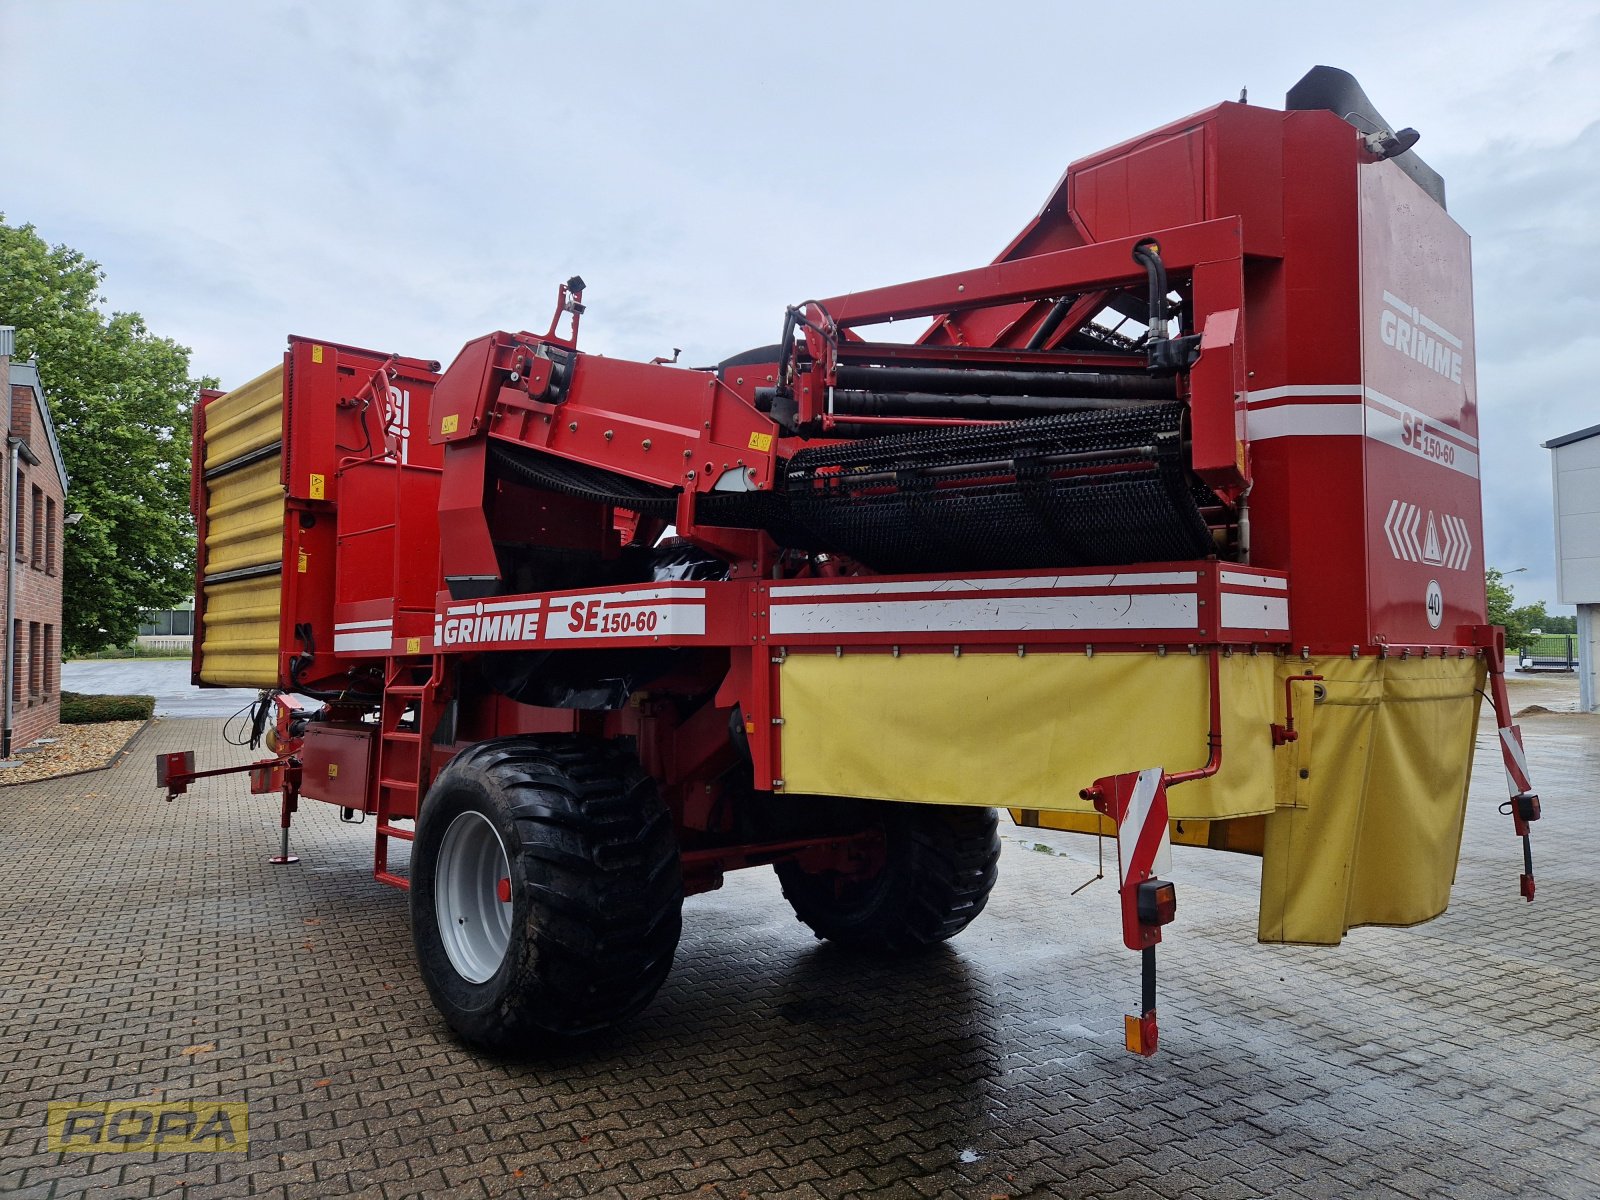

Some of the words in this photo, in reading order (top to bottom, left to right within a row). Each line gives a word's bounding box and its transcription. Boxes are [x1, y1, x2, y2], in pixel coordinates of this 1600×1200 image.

[1379, 307, 1463, 385] GRIMME
[1401, 411, 1424, 451] SE
[1423, 435, 1455, 466] 150-60
[444, 601, 541, 644] GRIMME
[567, 600, 601, 633] SE
[600, 610, 658, 633] 150-60
[1428, 593, 1440, 616] 40
